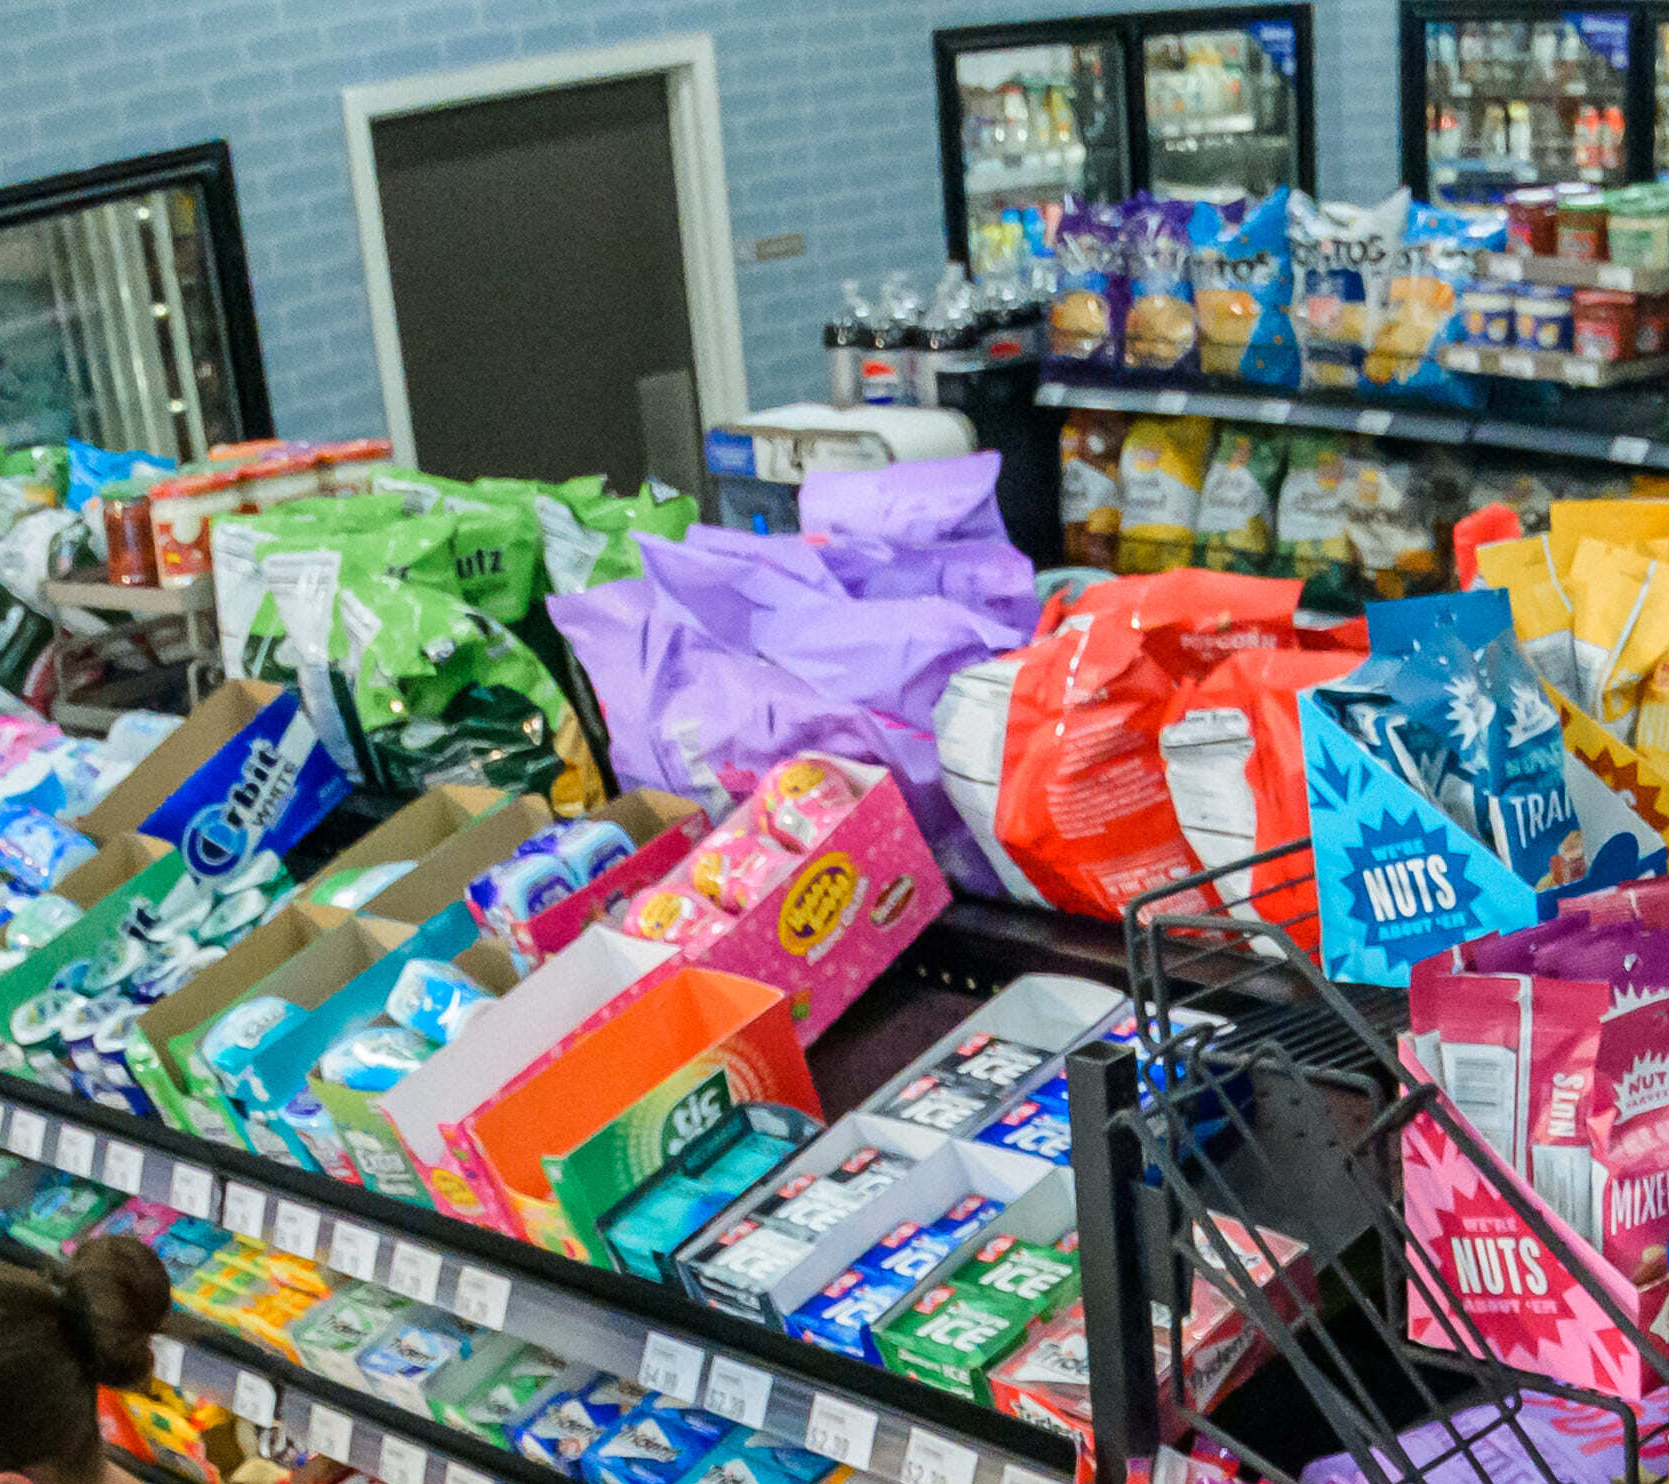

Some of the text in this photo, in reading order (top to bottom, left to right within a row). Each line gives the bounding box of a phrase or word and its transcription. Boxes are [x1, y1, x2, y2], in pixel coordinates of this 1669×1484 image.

[182, 737, 283, 880] Orbit
[1362, 854, 1457, 922] NUTS
[1547, 1072, 1585, 1137] NUTS
[1628, 1069, 1669, 1094] NUT
[979, 1263, 1052, 1300] ICE
[1450, 1236, 1549, 1297] NUTS
[918, 1313, 1001, 1353] ICE
